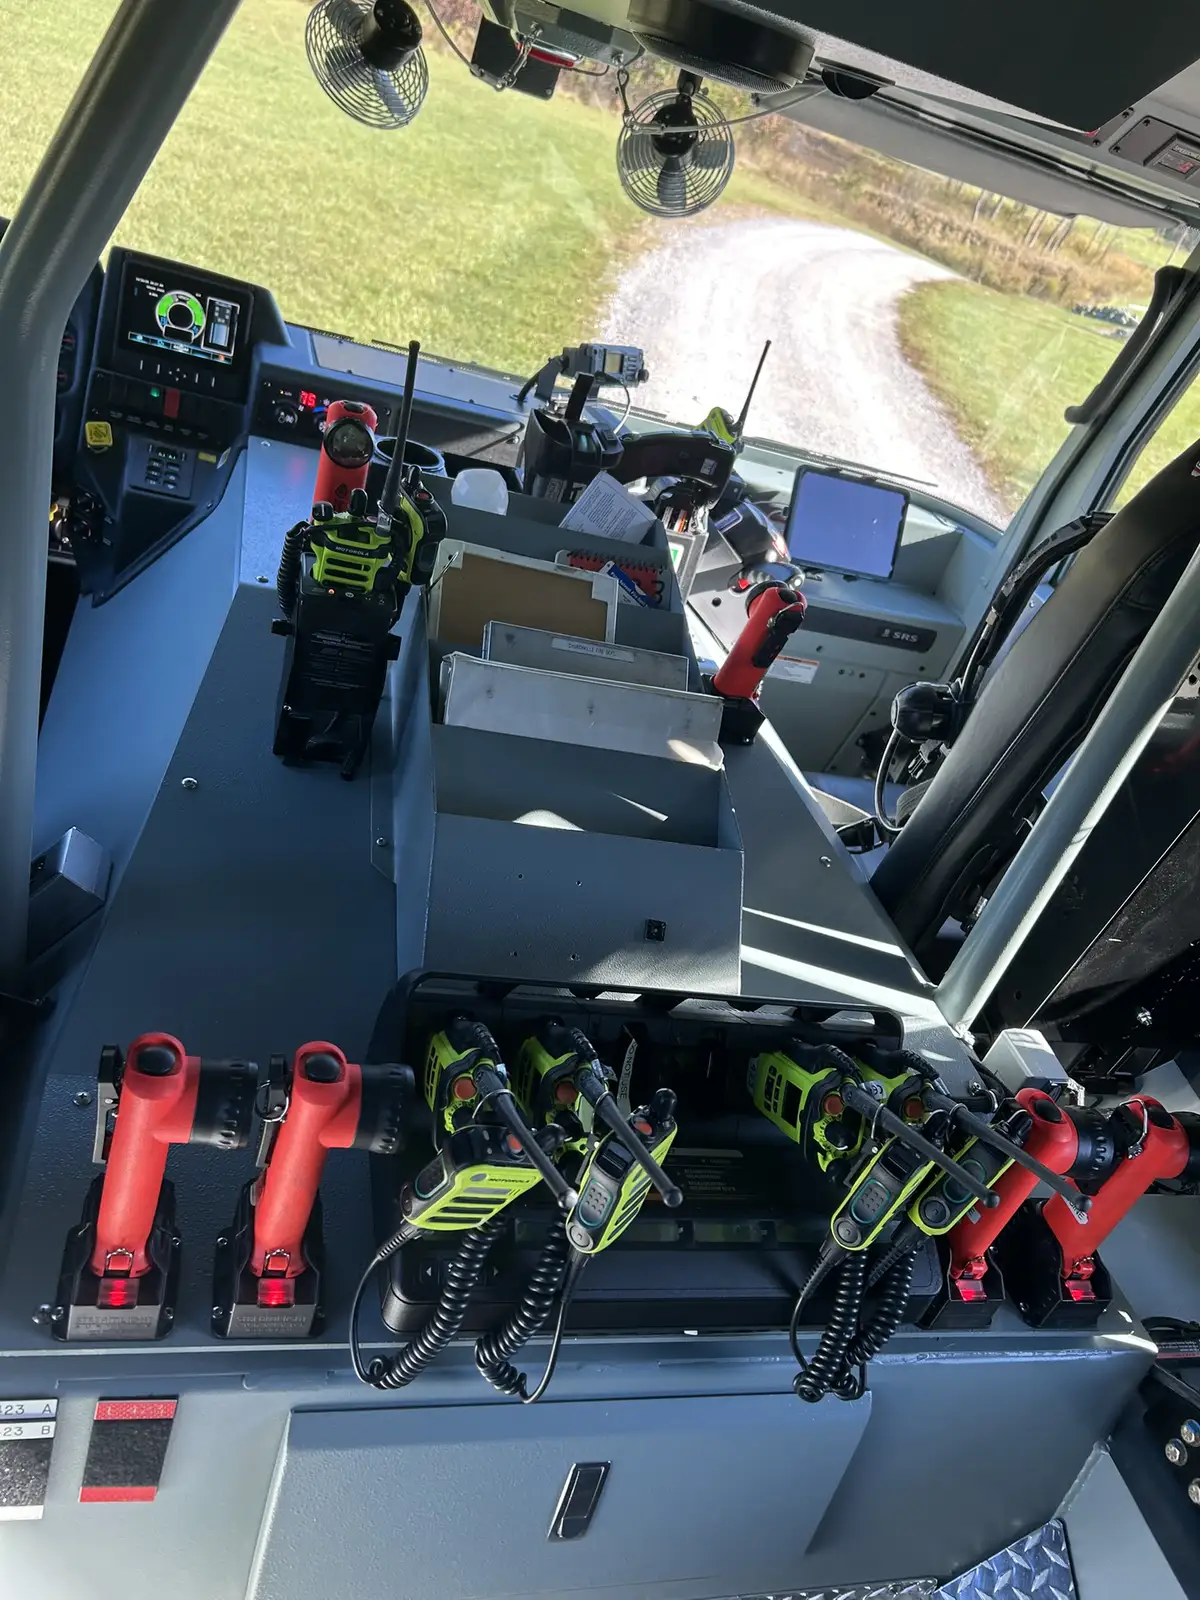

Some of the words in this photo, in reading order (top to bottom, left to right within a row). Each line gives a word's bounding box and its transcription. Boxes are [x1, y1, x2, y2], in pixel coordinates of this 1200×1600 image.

[335, 546, 369, 556] MOTOROLA
[892, 631, 918, 643] SRS
[624, 1056, 633, 1077] NOT
[620, 1080, 628, 1099] USE
[0, 1404, 25, 1416] 23
[41, 1403, 53, 1416] A
[0, 1426, 24, 1437] 23
[41, 1425, 51, 1435] B
